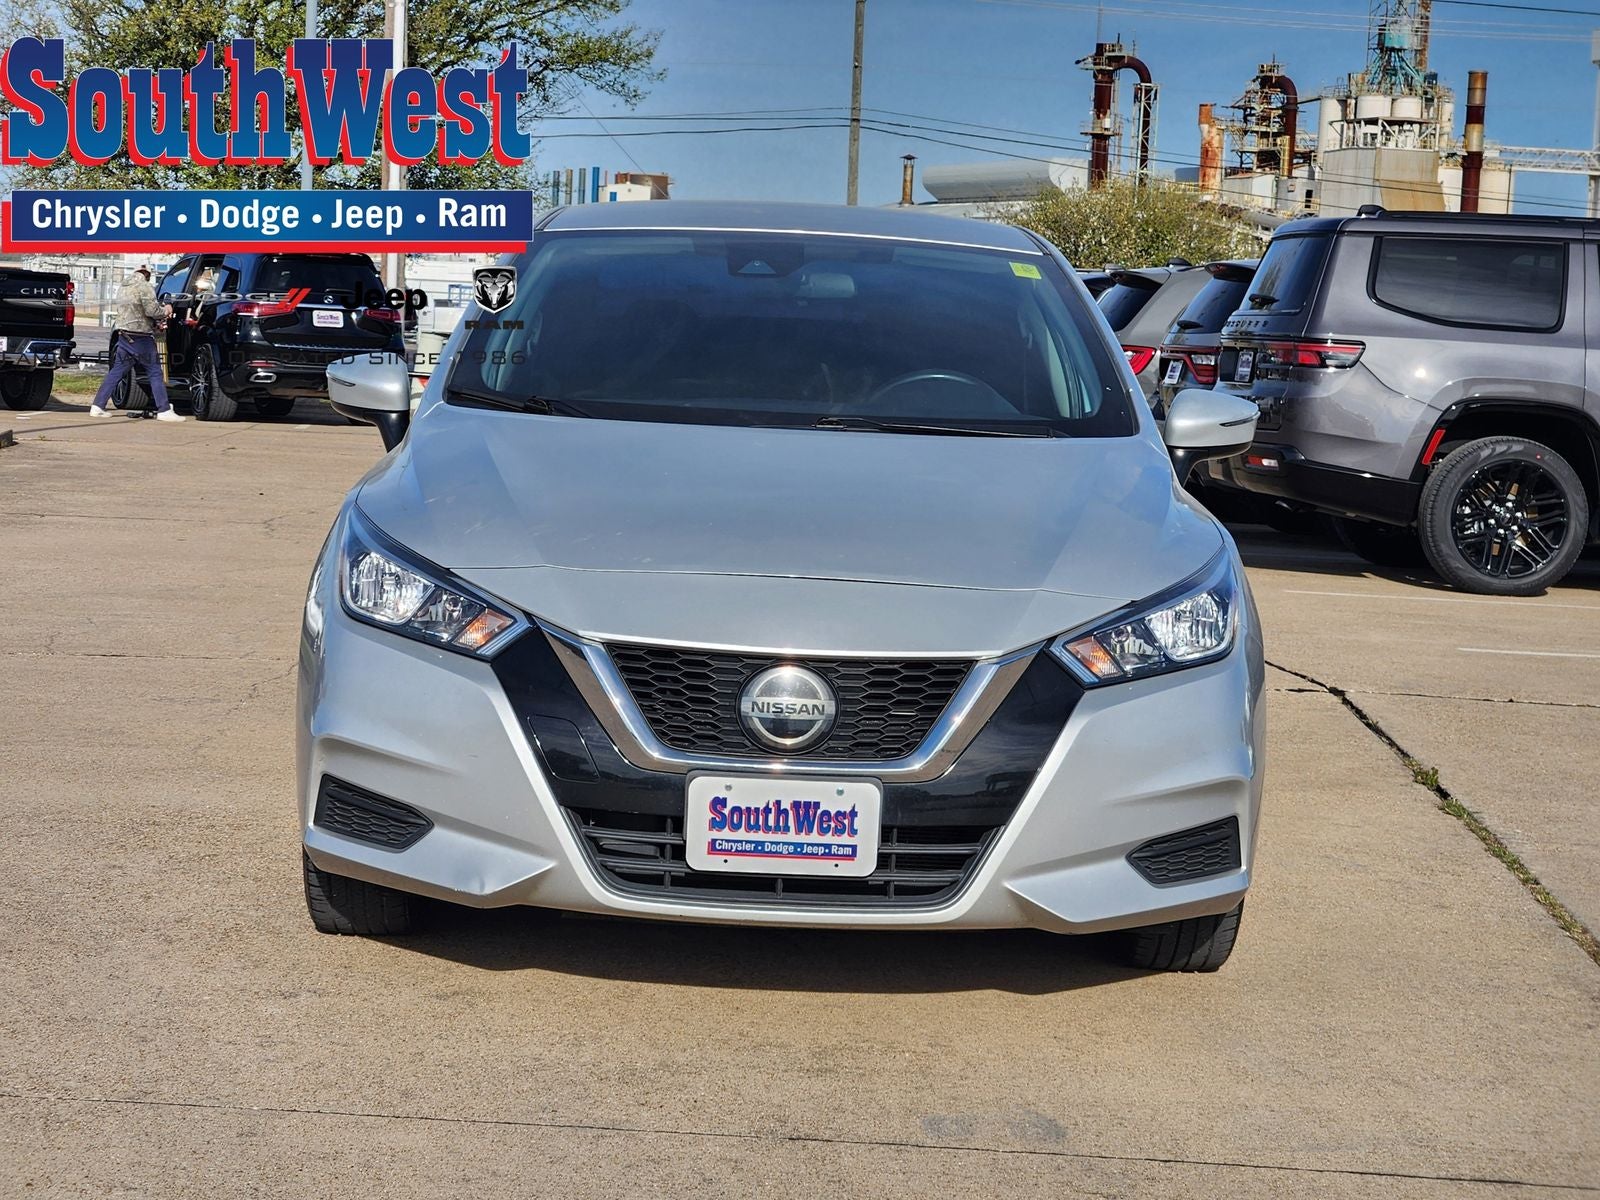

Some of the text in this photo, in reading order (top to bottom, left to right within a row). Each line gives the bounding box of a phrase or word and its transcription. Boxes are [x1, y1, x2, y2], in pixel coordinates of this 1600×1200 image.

[751, 701, 826, 716] NISSAN
[708, 796, 859, 838] SouthWest
[715, 839, 852, 856] Chrysler Dodge Jeep Ram
